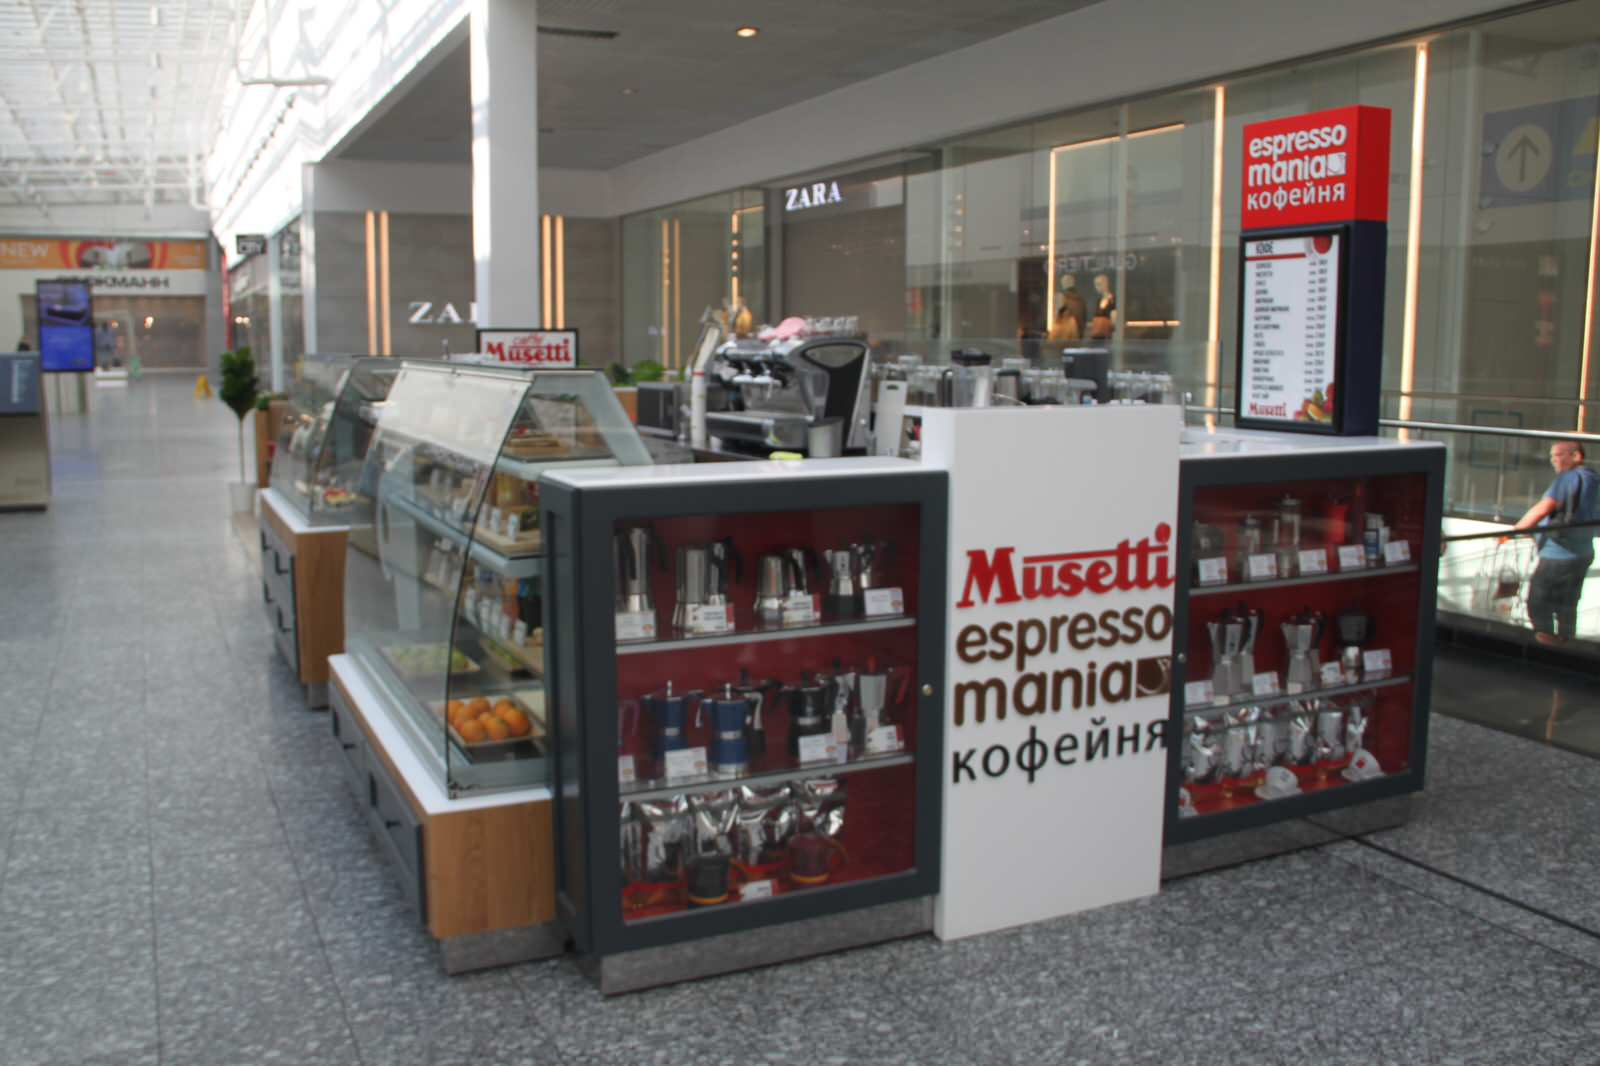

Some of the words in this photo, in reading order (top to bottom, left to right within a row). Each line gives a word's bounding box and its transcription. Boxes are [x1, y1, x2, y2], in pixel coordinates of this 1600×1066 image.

[1249, 124, 1347, 161] espresso
[1248, 155, 1326, 187] mania
[785, 181, 842, 211] ZARA
[1247, 182, 1346, 211] кофейня
[486, 338, 572, 362] Musetti
[956, 522, 1176, 608] Musetti
[956, 604, 1173, 672] espresso
[953, 661, 1132, 727] mania
[952, 716, 1170, 784] кофейня
